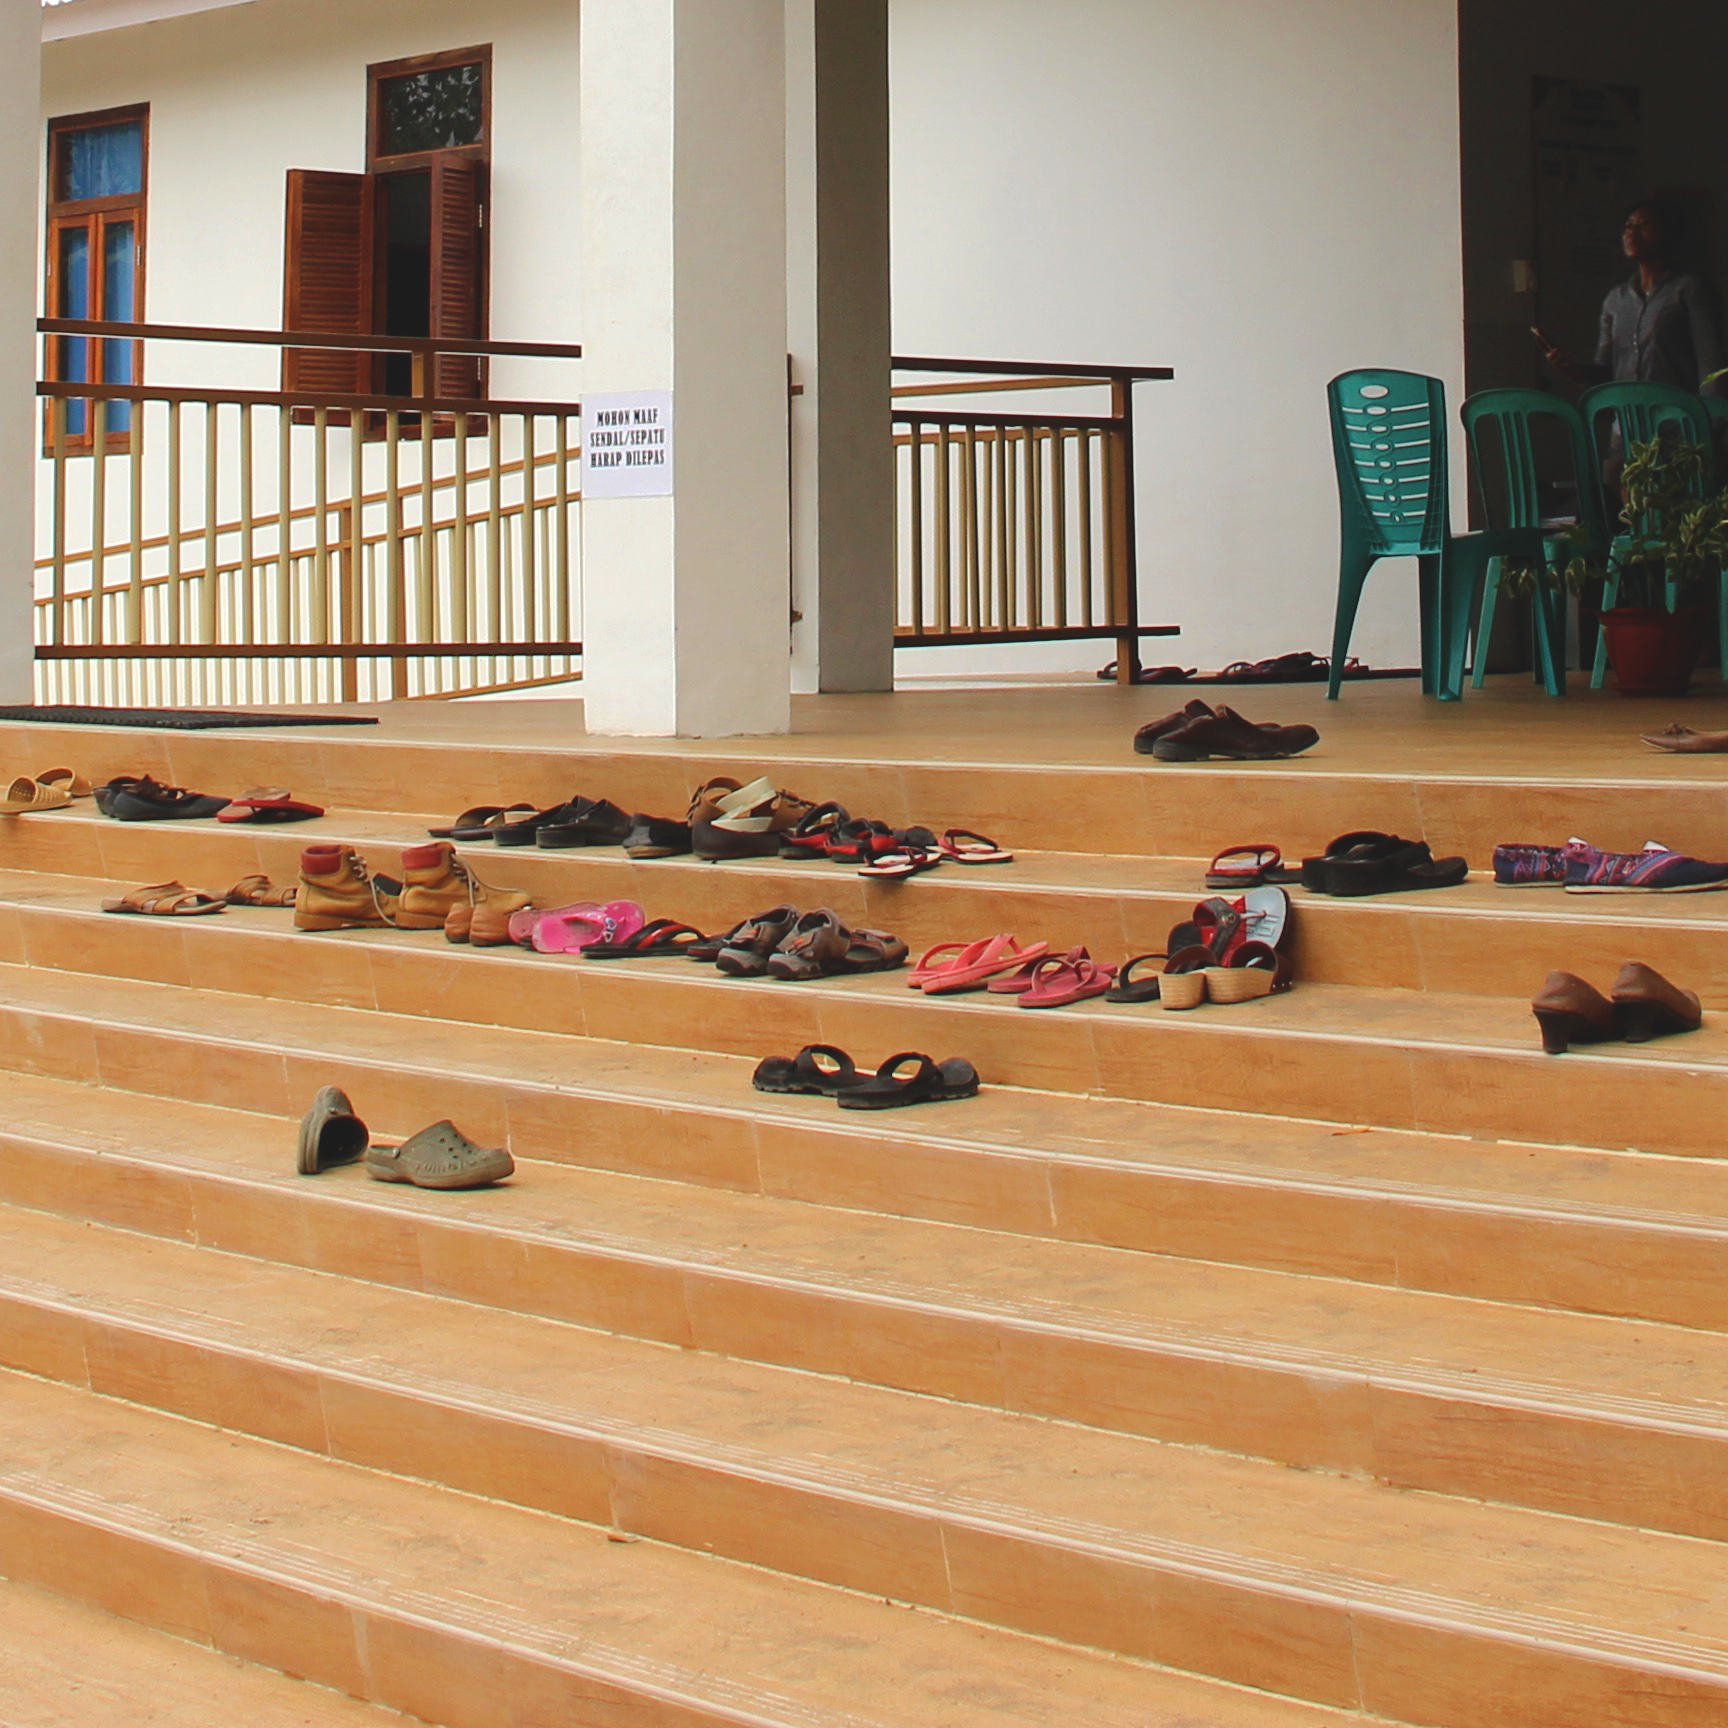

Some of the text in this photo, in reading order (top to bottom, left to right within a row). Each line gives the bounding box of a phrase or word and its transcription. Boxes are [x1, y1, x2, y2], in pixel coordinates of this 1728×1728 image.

[596, 408, 658, 427] MOHON MAAF
[590, 428, 665, 448] SENDAL/SEPATU
[590, 449, 665, 468] HARAP DILEPAS
